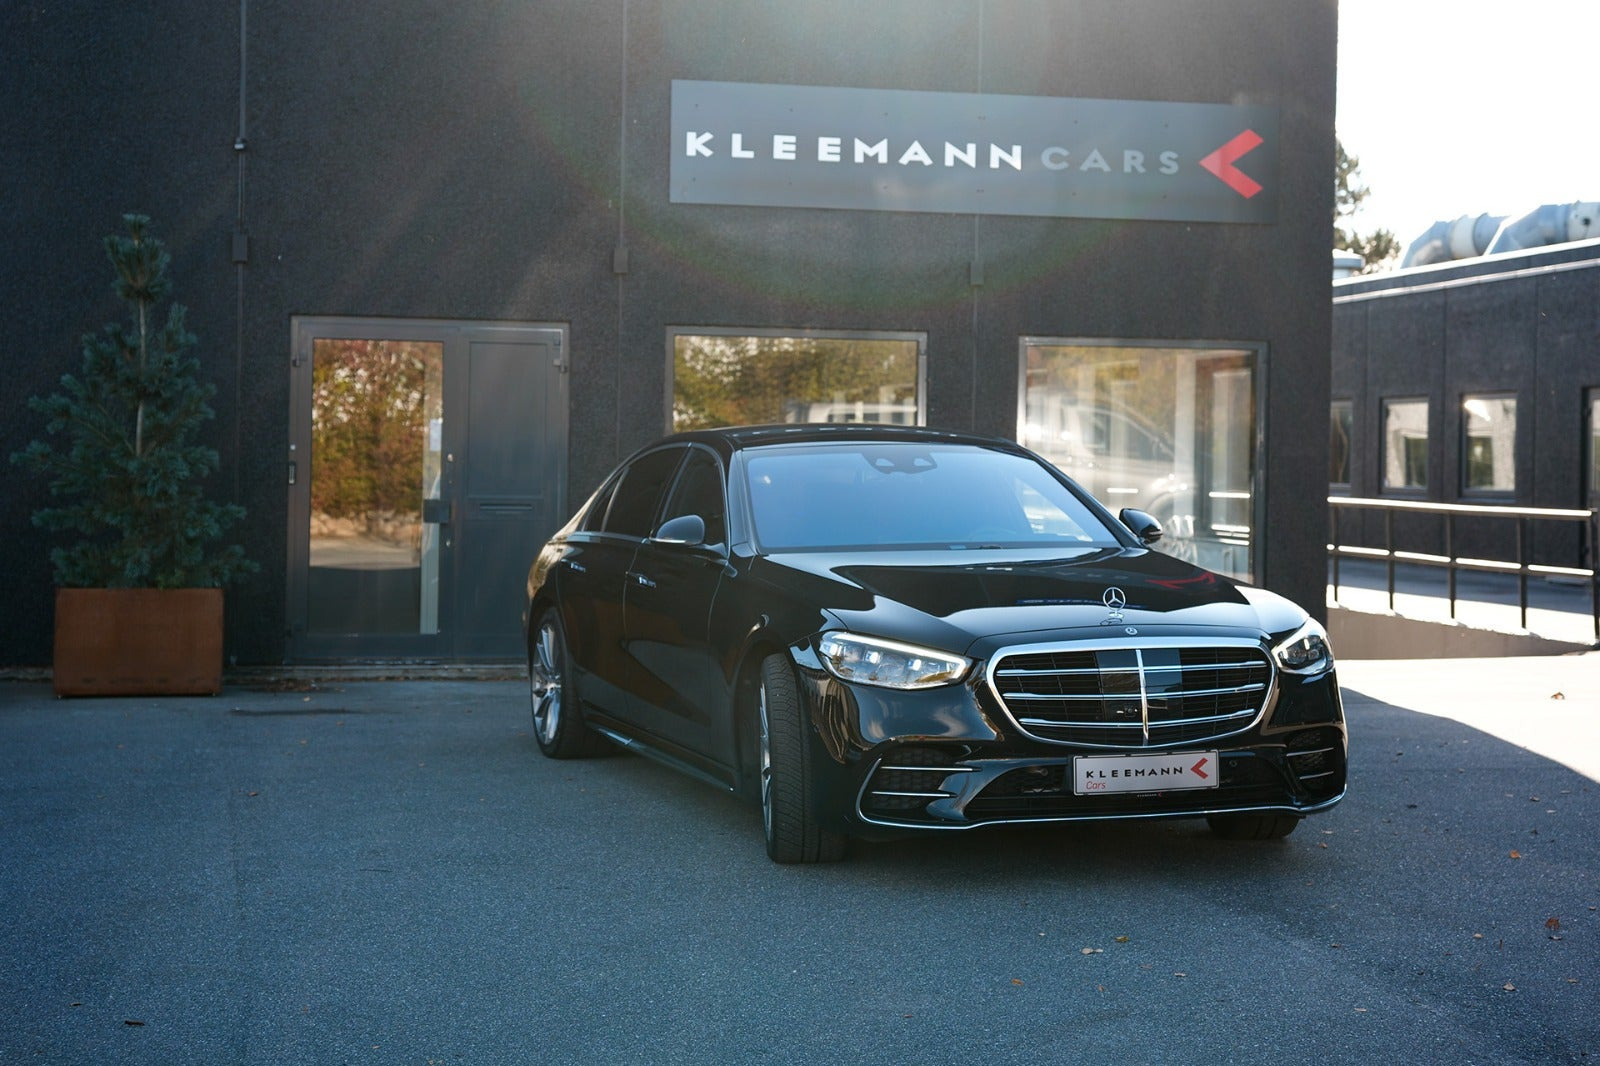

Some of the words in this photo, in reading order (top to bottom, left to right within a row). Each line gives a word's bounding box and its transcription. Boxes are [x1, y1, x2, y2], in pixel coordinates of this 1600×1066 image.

[685, 131, 1023, 171] KLEEMANN
[1041, 146, 1180, 174] CARS
[1086, 766, 1183, 778] KLEEMANN
[1086, 781, 1106, 790] Cars
